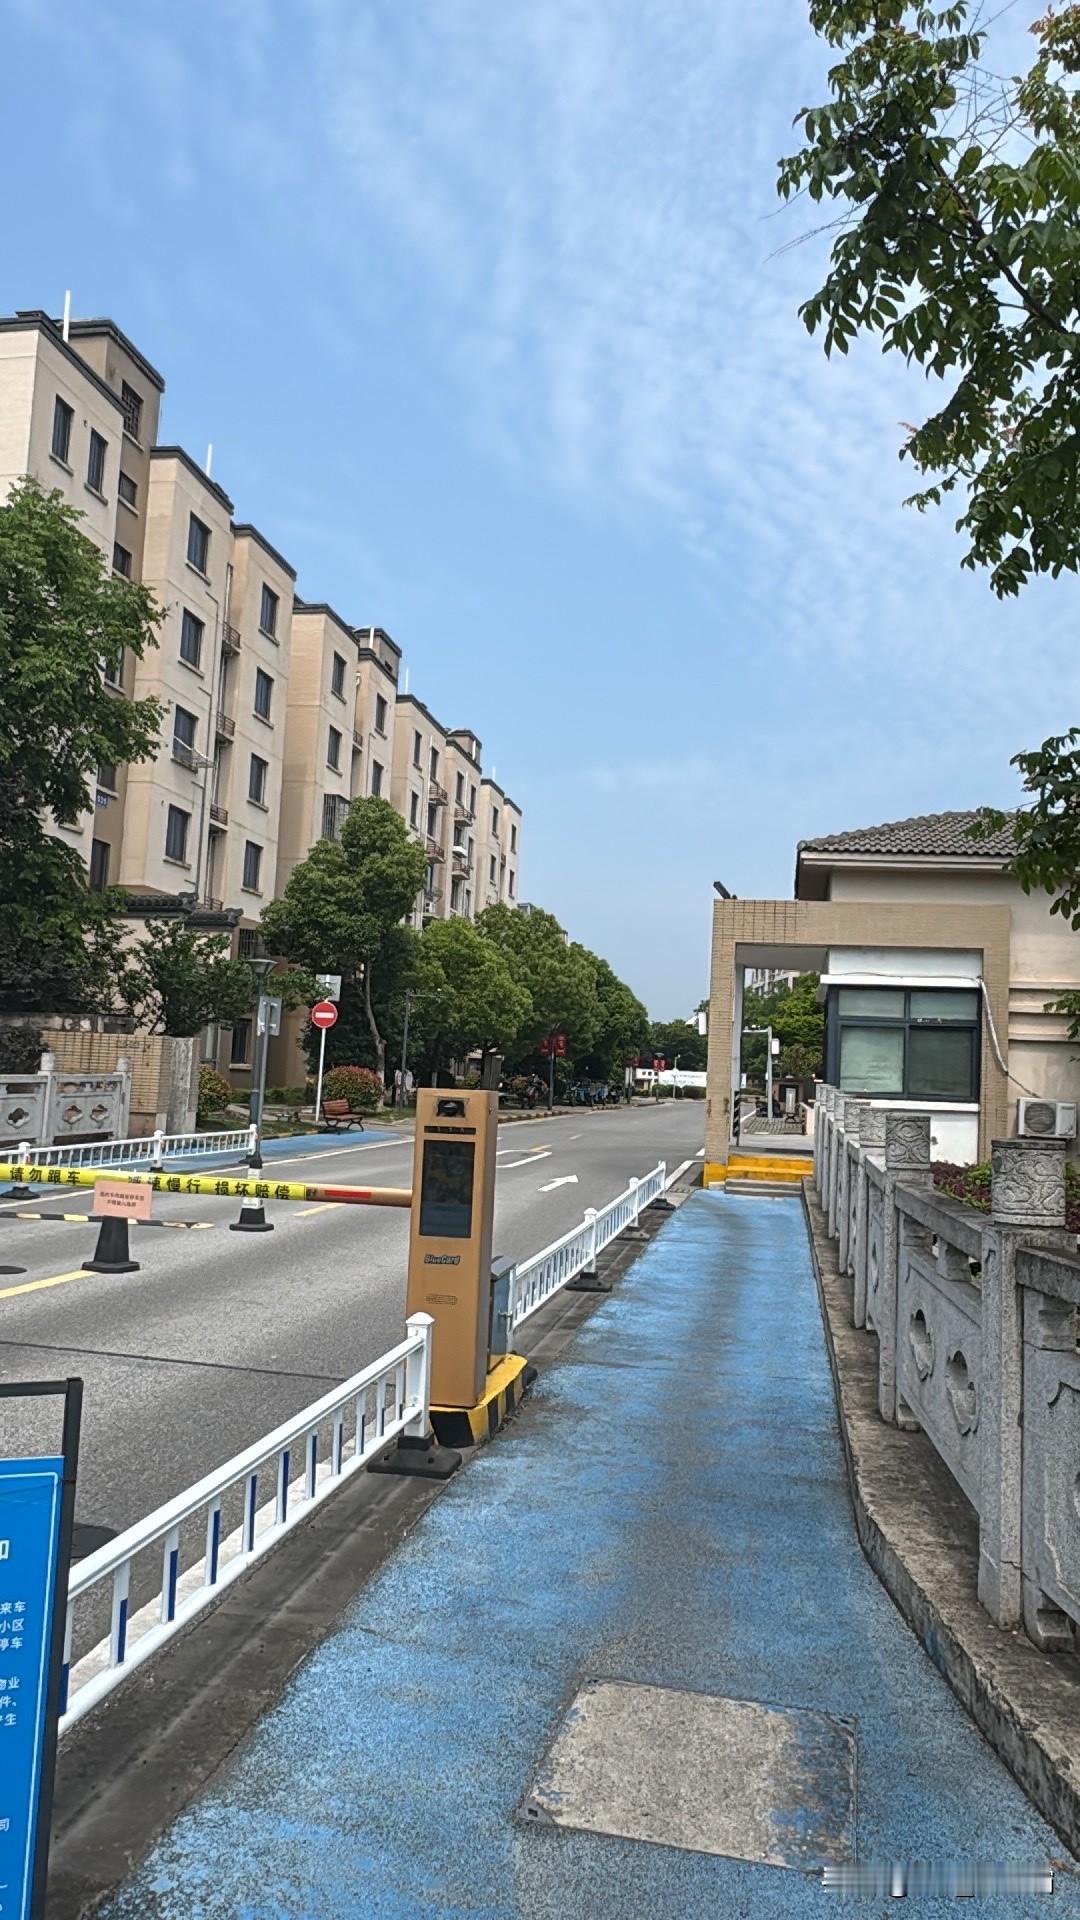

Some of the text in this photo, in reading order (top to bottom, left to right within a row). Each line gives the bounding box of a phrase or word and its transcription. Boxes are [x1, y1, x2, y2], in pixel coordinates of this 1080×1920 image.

[10, 1167, 80, 1185] 请勿跟车
[215, 1181, 291, 1200] 损坏赔偿
[0, 1600, 26, 1615] 来车
[0, 1618, 25, 1634] 小区
[0, 1712, 17, 1727] 生
